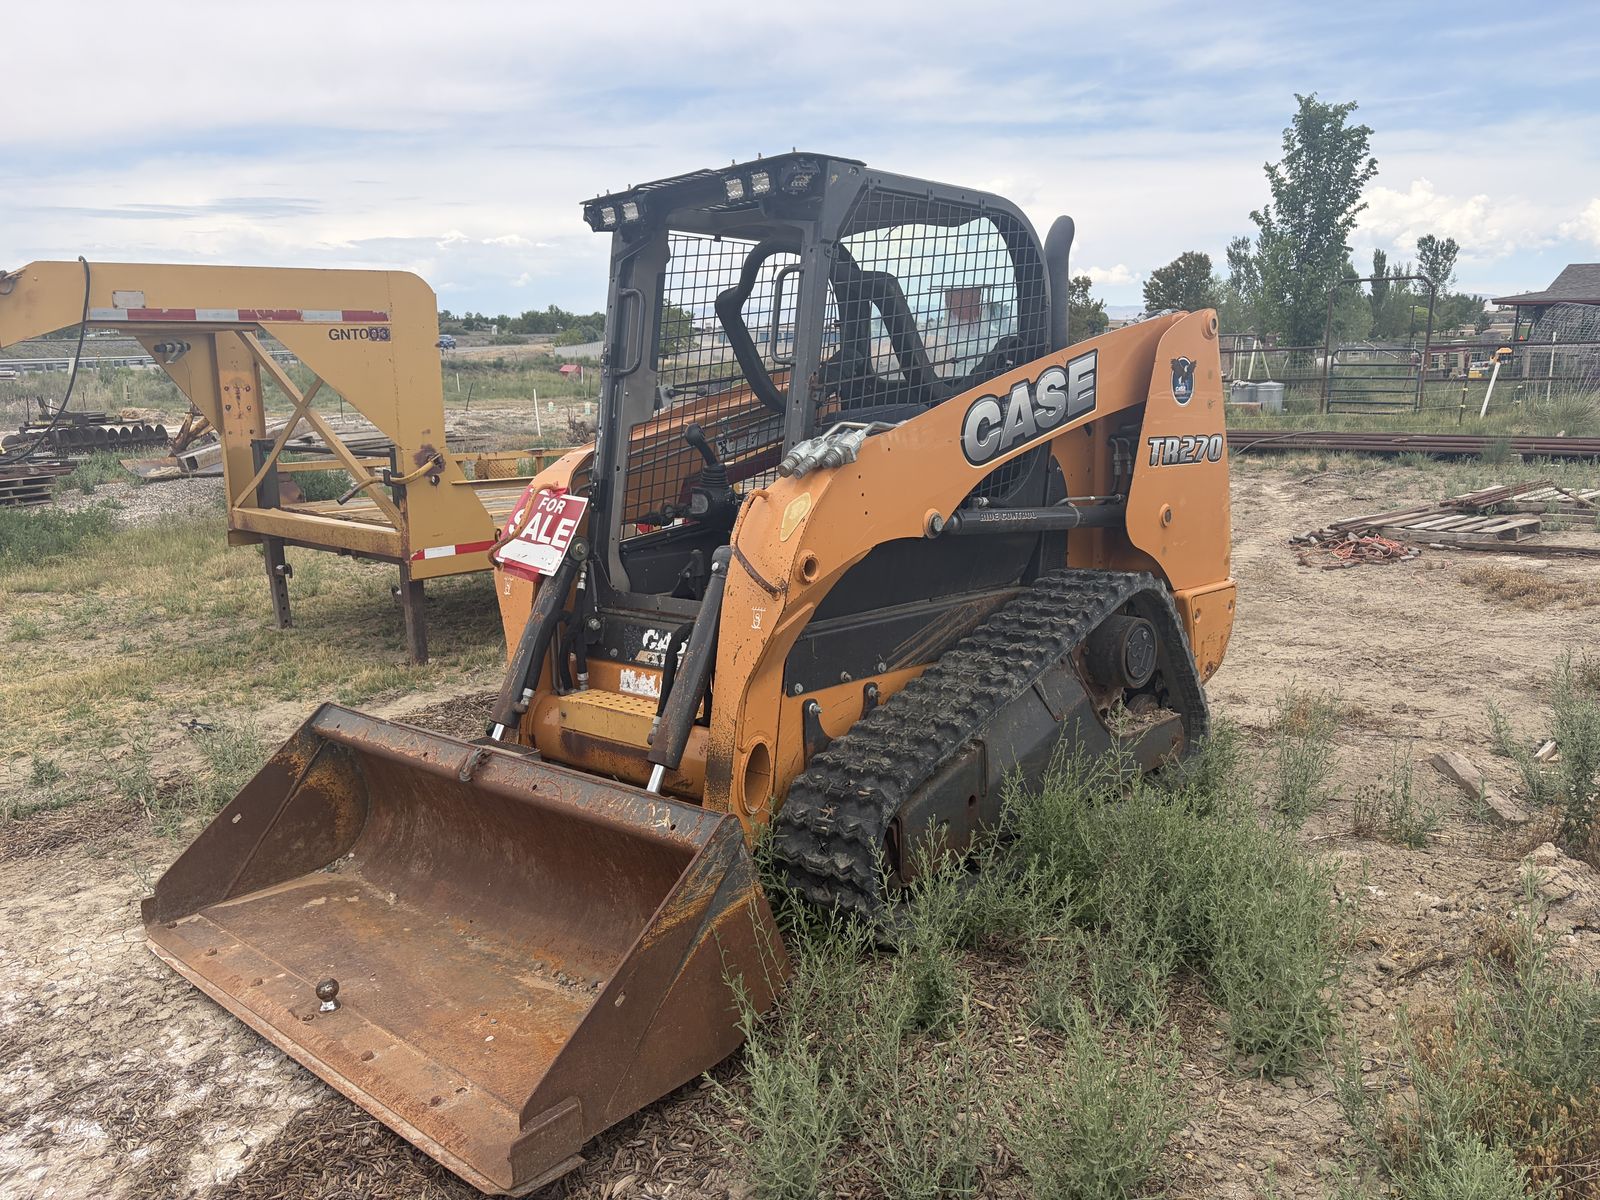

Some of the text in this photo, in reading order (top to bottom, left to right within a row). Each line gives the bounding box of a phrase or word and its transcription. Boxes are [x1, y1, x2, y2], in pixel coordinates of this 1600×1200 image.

[962, 351, 1097, 465] CASE
[1148, 433, 1223, 466] TR270
[537, 497, 567, 514] FOR
[642, 629, 691, 656] CA
